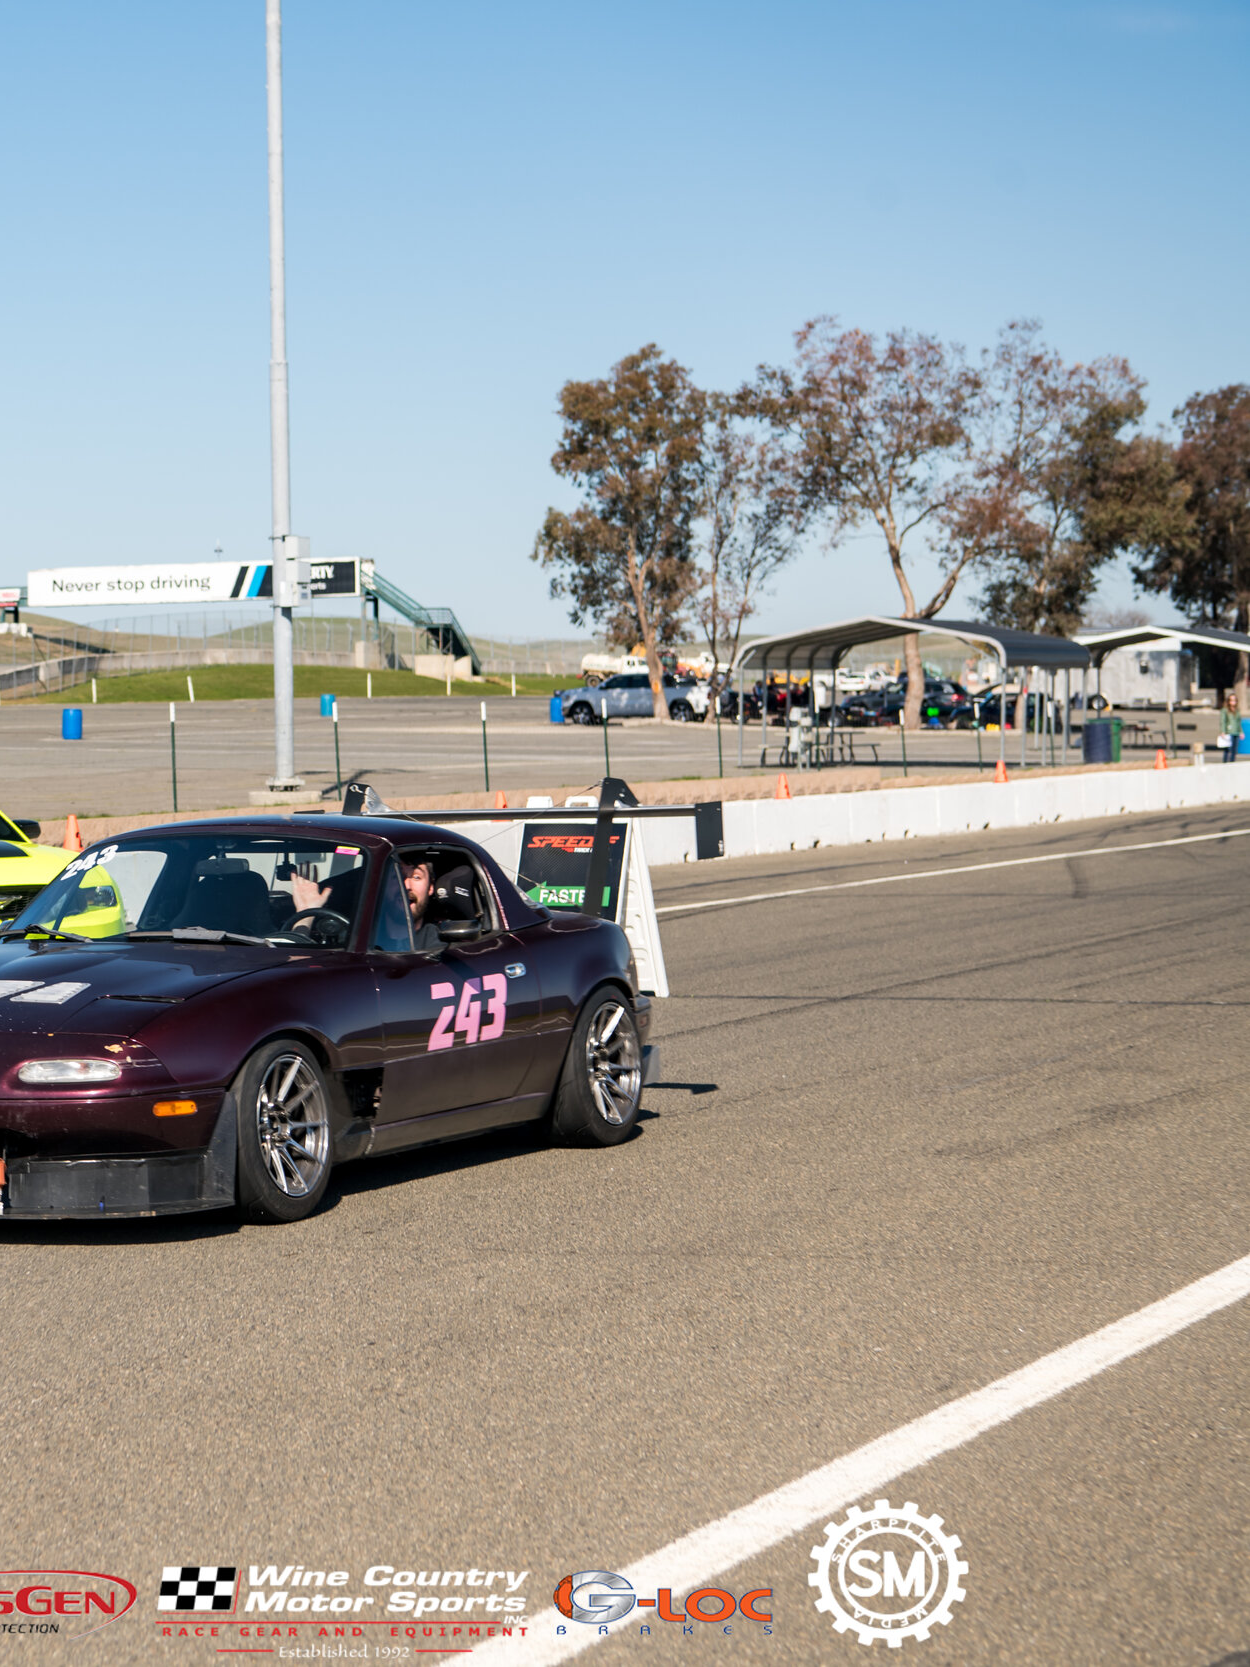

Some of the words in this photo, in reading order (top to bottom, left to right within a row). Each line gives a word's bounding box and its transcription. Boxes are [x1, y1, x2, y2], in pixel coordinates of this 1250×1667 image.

[52, 579, 101, 593] Never
[107, 578, 145, 593] stop
[150, 575, 211, 591] driving
[528, 836, 620, 848] SPEEDF
[60, 844, 119, 881] 243
[539, 889, 586, 904] FASTE
[428, 973, 507, 1051] 243
